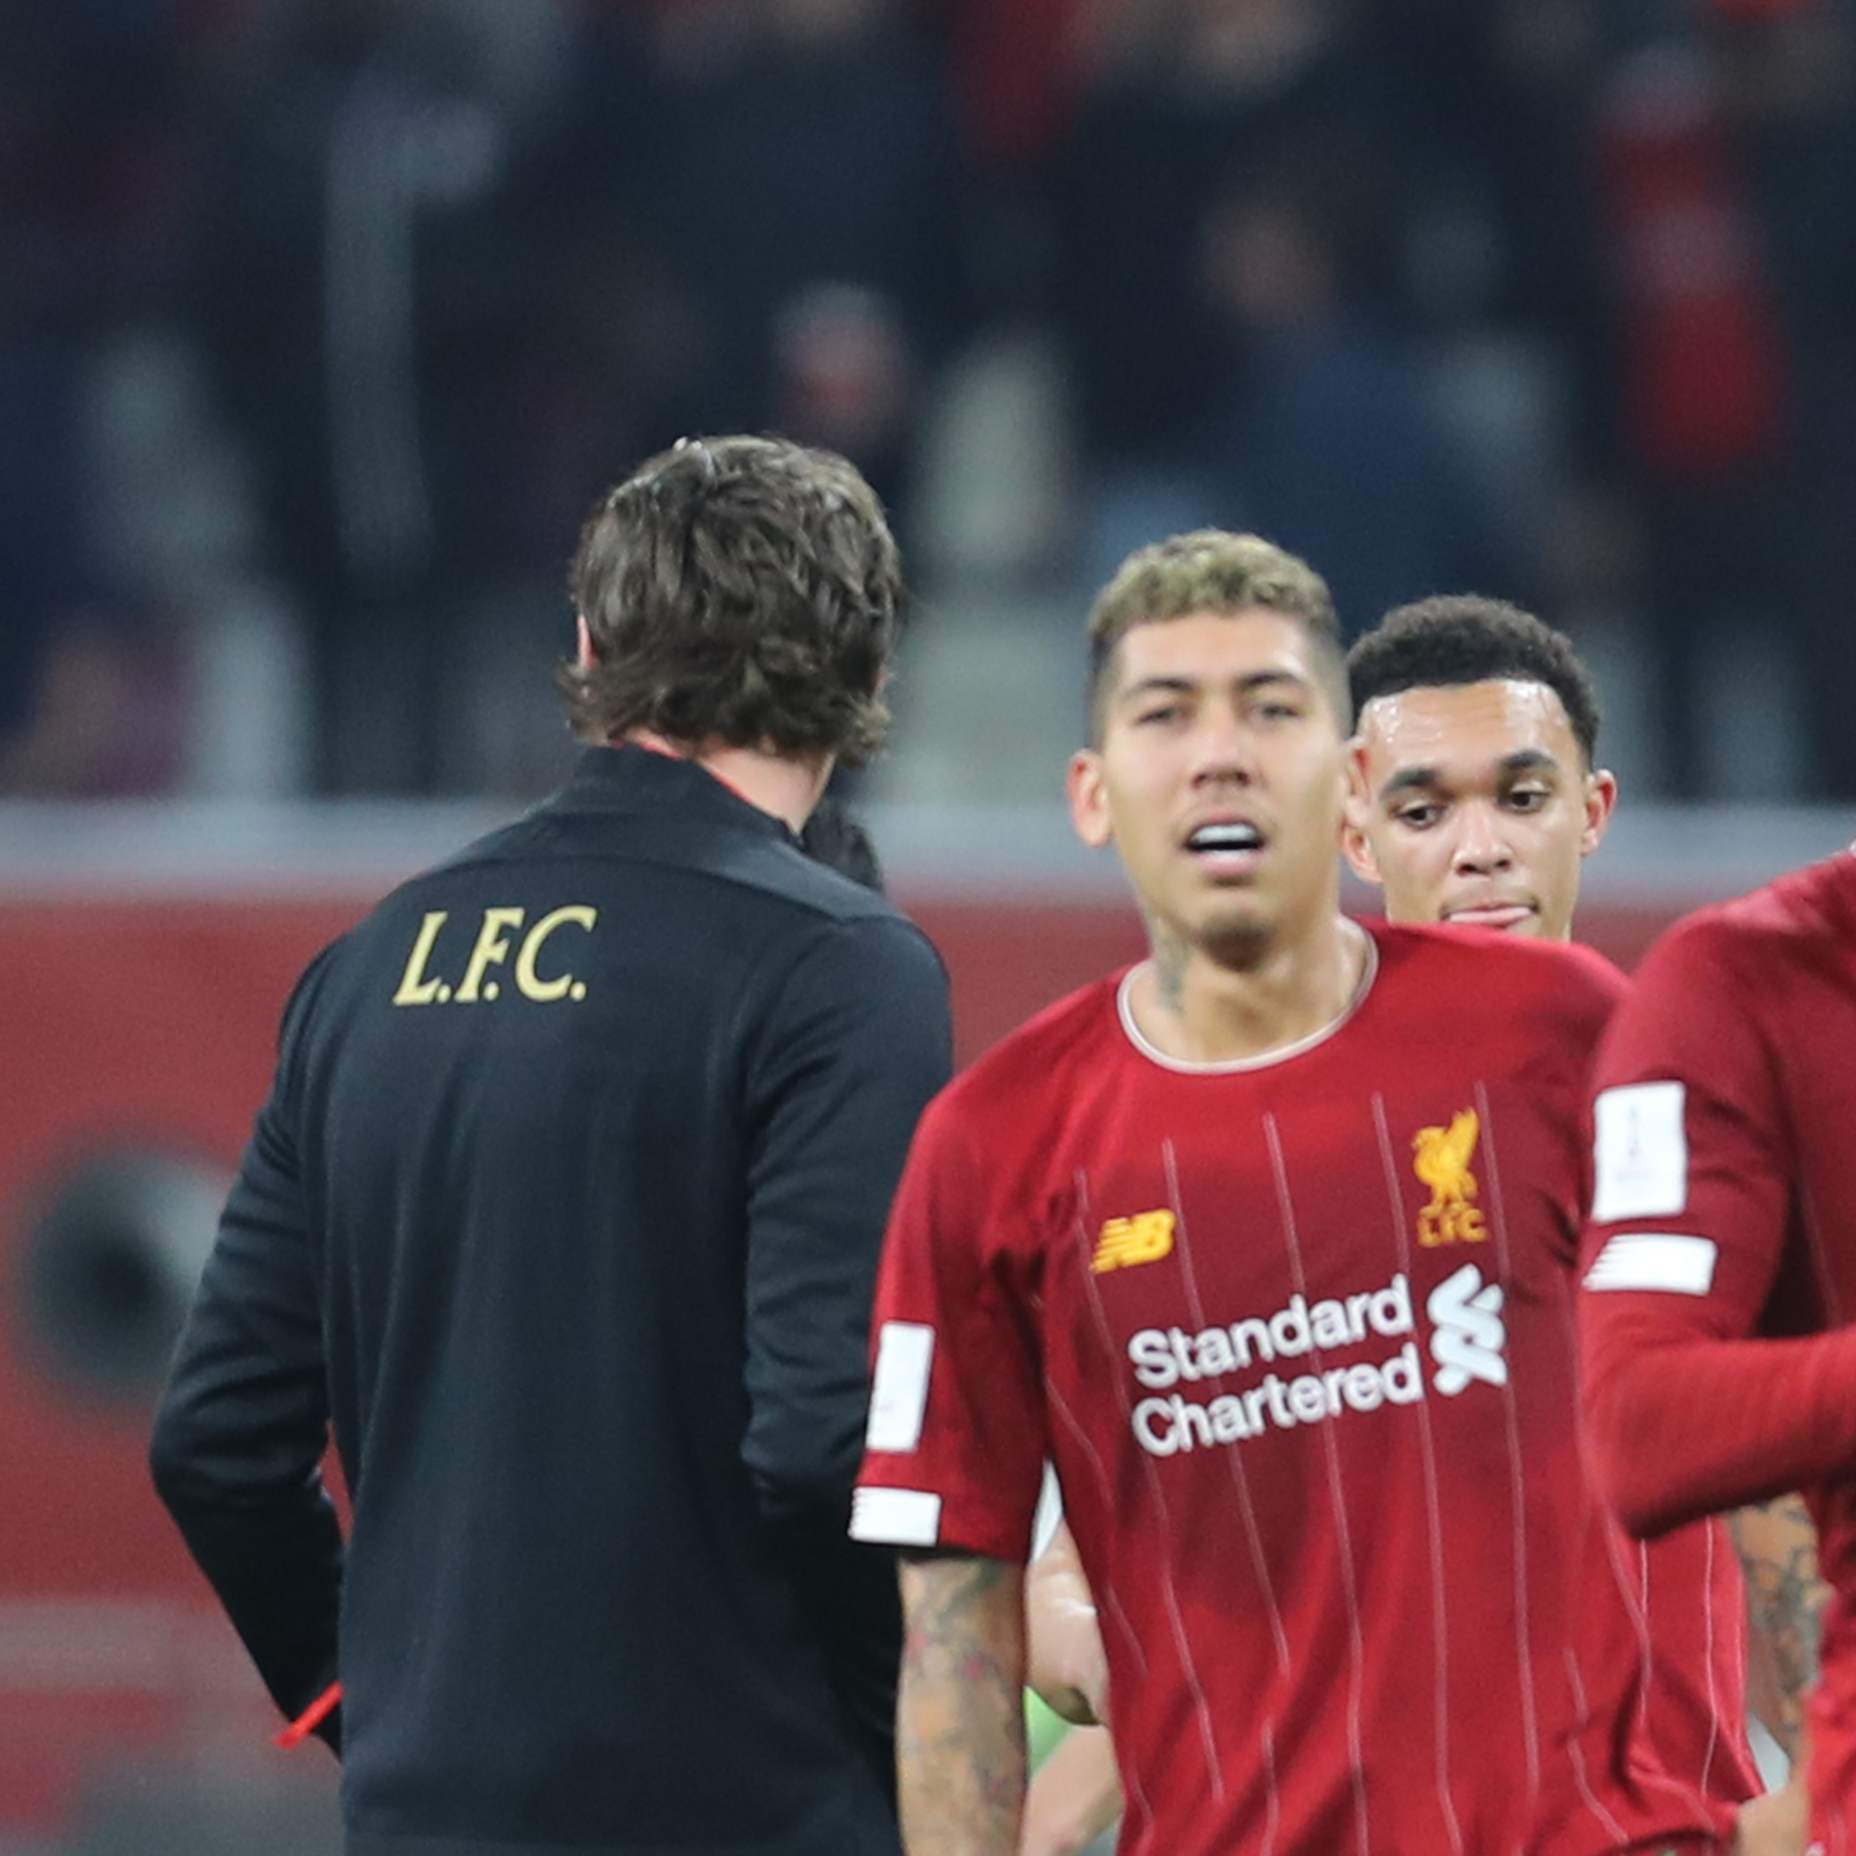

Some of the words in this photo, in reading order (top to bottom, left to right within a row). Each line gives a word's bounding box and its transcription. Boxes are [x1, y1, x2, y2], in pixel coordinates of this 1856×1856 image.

[392, 904, 598, 1007] L.F.C.
[1127, 1272, 1415, 1389] Standard
[1130, 1340, 1426, 1458] Chartered
